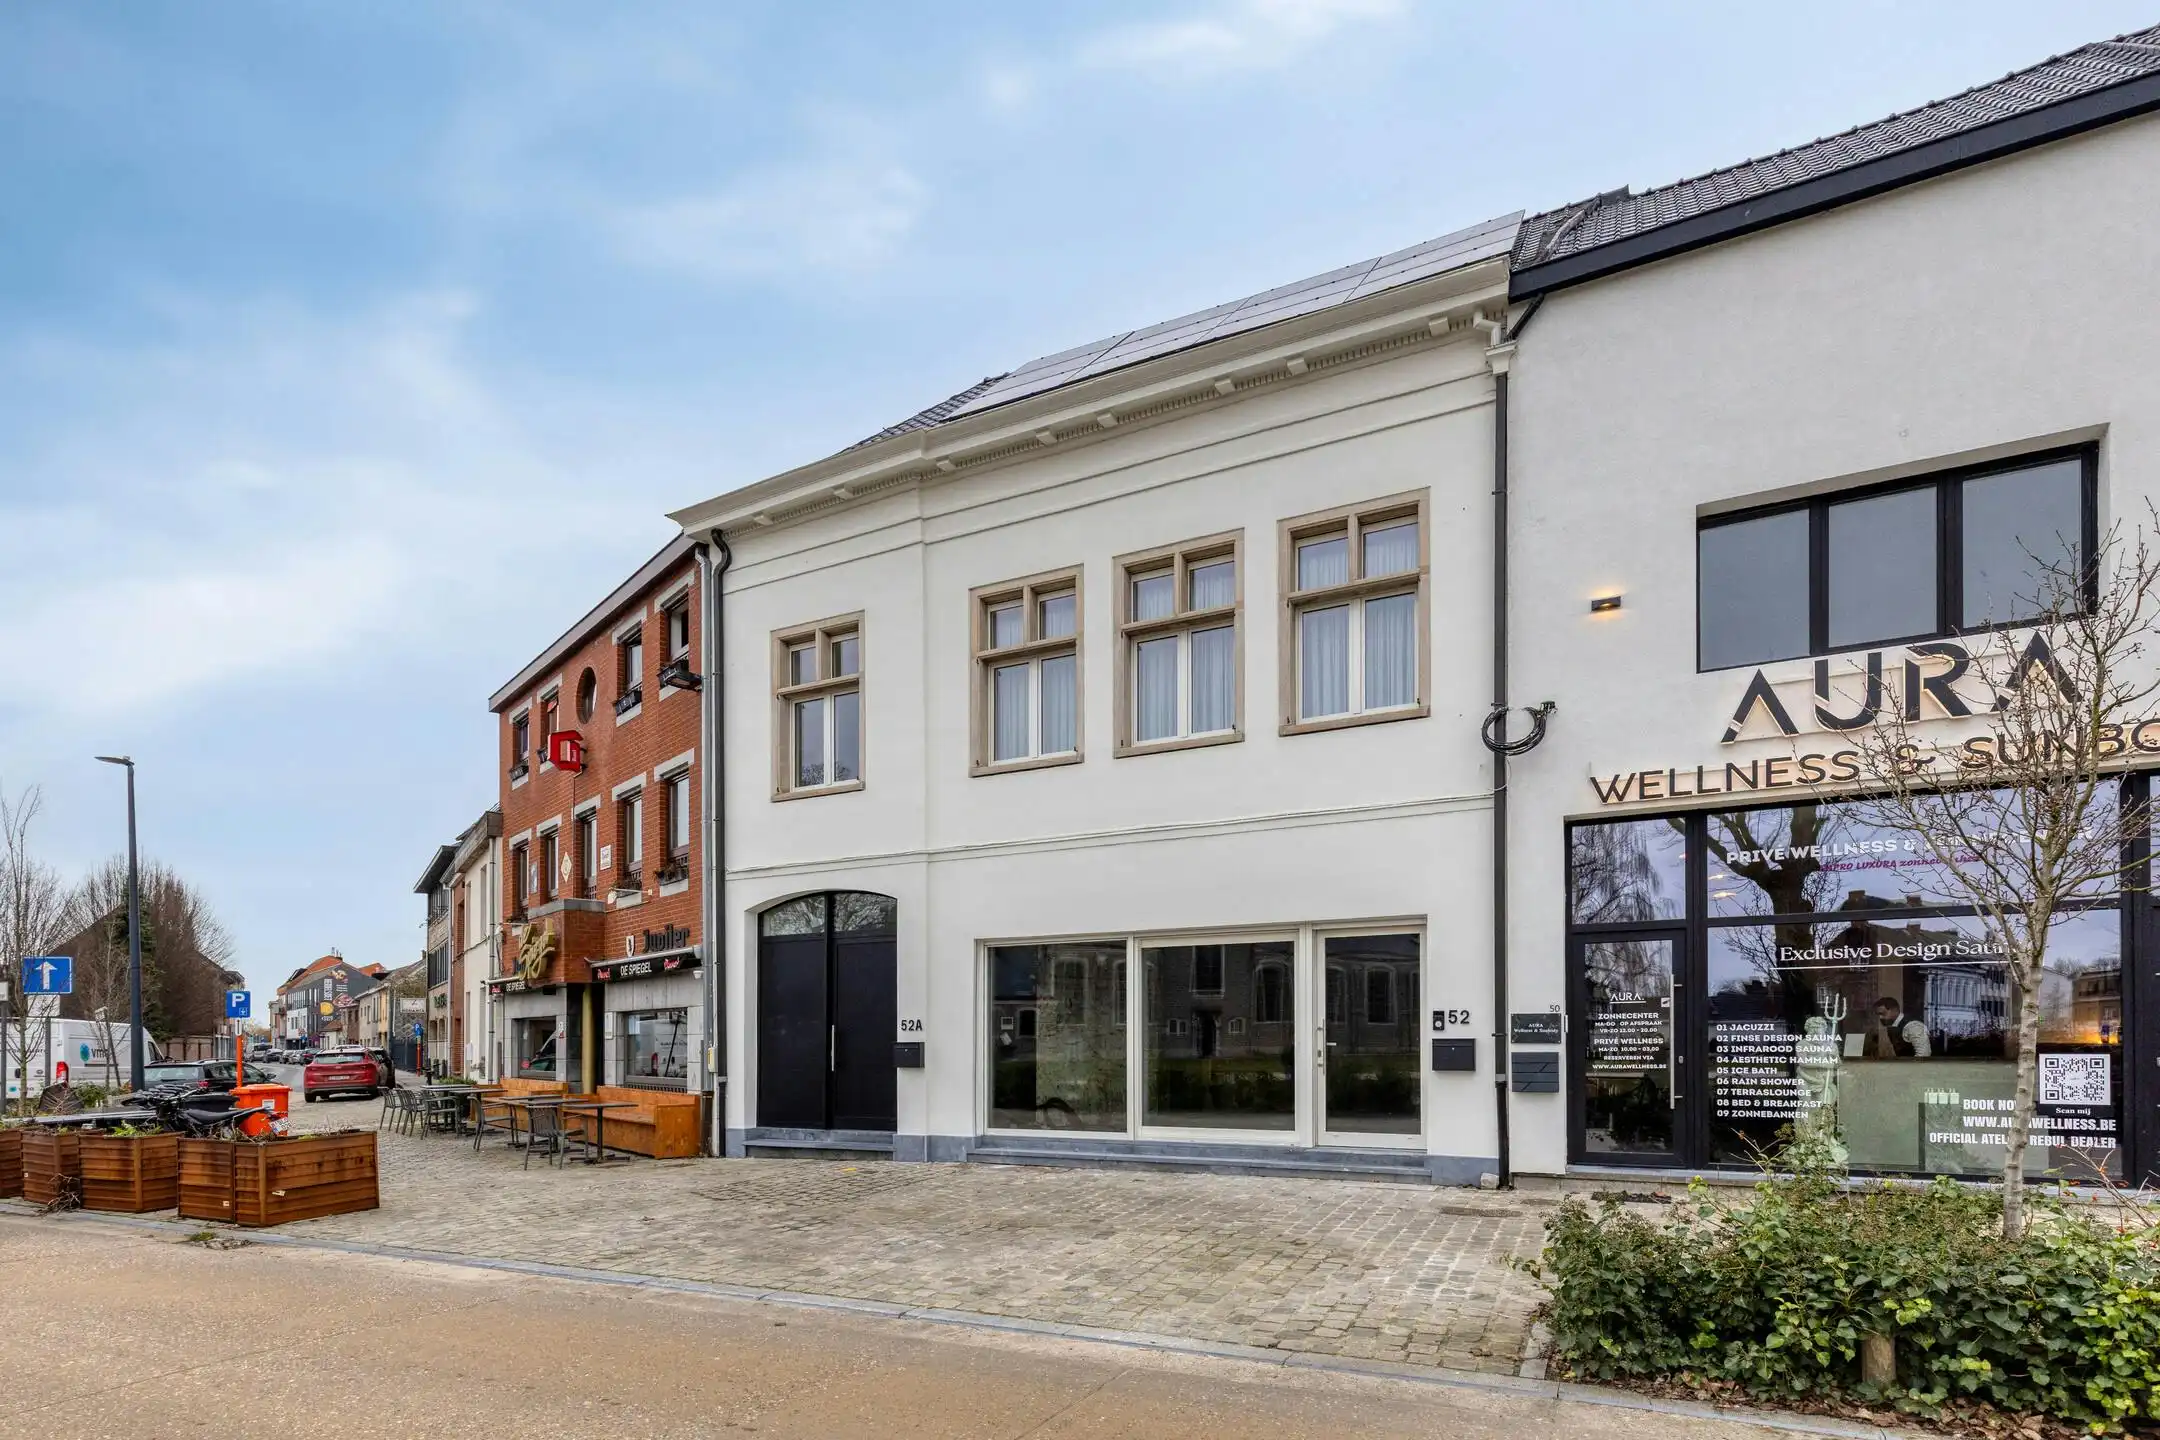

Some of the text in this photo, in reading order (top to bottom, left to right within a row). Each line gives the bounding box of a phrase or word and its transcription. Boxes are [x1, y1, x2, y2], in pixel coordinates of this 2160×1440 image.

[1721, 631, 2084, 743] AURA
[1590, 751, 1860, 804] WELLNESS
[1791, 840, 1897, 860] WELLNESS
[1780, 945, 1872, 961] Exclusive
[1876, 942, 1952, 961] Design
[620, 961, 652, 977] DE SPIEGEL
[232, 993, 245, 1007] P
[1550, 1004, 1560, 1012] 50
[1448, 1010, 1470, 1024] 52
[901, 1019, 922, 1031] 52A
[1805, 1034, 1842, 1042] SAUNA
[1716, 1045, 1832, 1053] 03 INFRAROOD SAUNA
[1716, 1056, 1838, 1064] 04 AESTHETIC HAMMAM
[1752, 1067, 1777, 1075] BATH
[1760, 1078, 1805, 1086] SHOWER
[1716, 1088, 1812, 1097] 07 TERRASLOUNGE
[1716, 1099, 1729, 1107] 08
[1732, 1099, 1751, 1107] BED
[1763, 1100, 1823, 1108] BREAKFAST
[1963, 1099, 2017, 1111] BOOK NO
[1732, 1110, 1809, 1119] ZONNEBANKEN
[2056, 1106, 2091, 1115] Scan mij
[1963, 1116, 2117, 1131] WWW.AWELLNESS.BE
[1930, 1132, 1978, 1145] OFFICIAL
[2029, 1136, 2066, 1147] REBUL
[2070, 1137, 2117, 1149] DEALER
